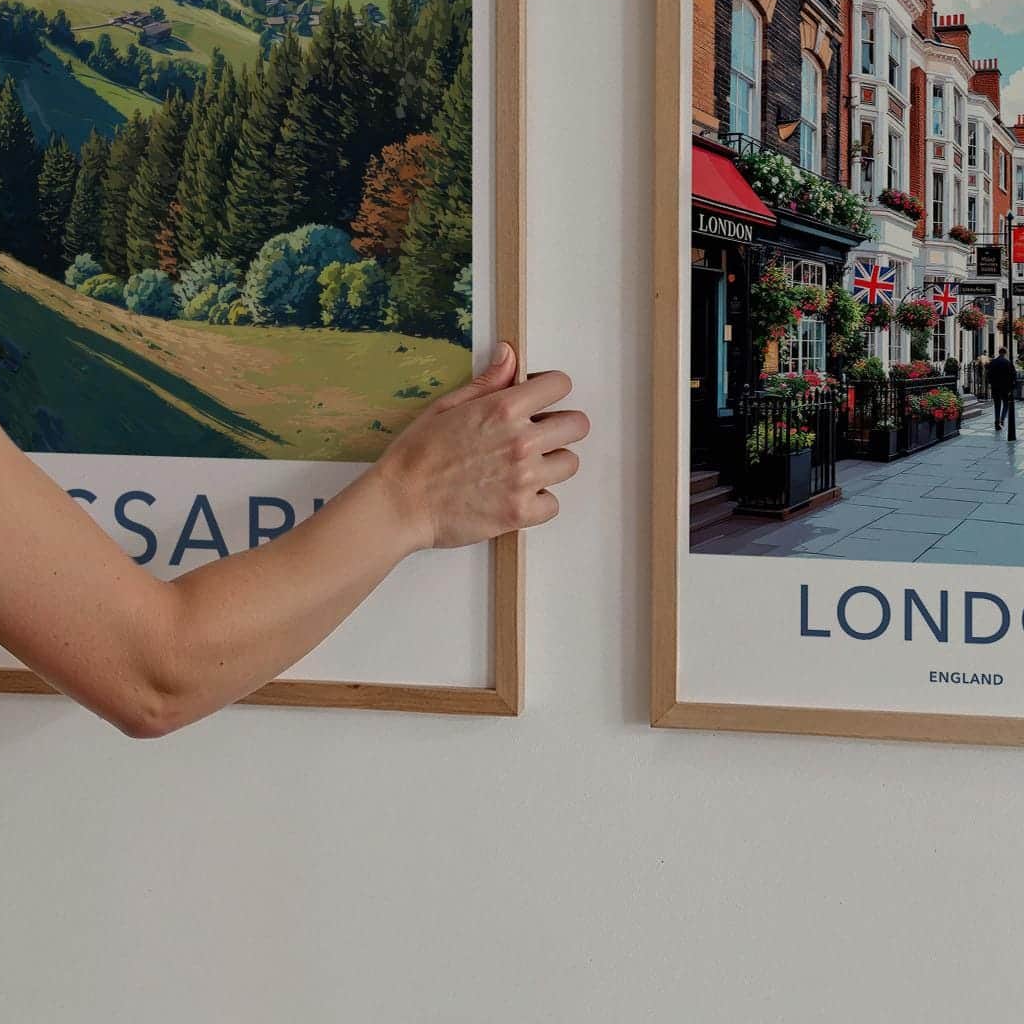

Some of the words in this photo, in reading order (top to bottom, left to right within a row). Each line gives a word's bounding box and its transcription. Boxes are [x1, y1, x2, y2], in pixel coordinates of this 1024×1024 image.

[698, 213, 753, 243] LONDON
[800, 583, 1024, 645] LOND
[929, 671, 1004, 686] ENGLAND
